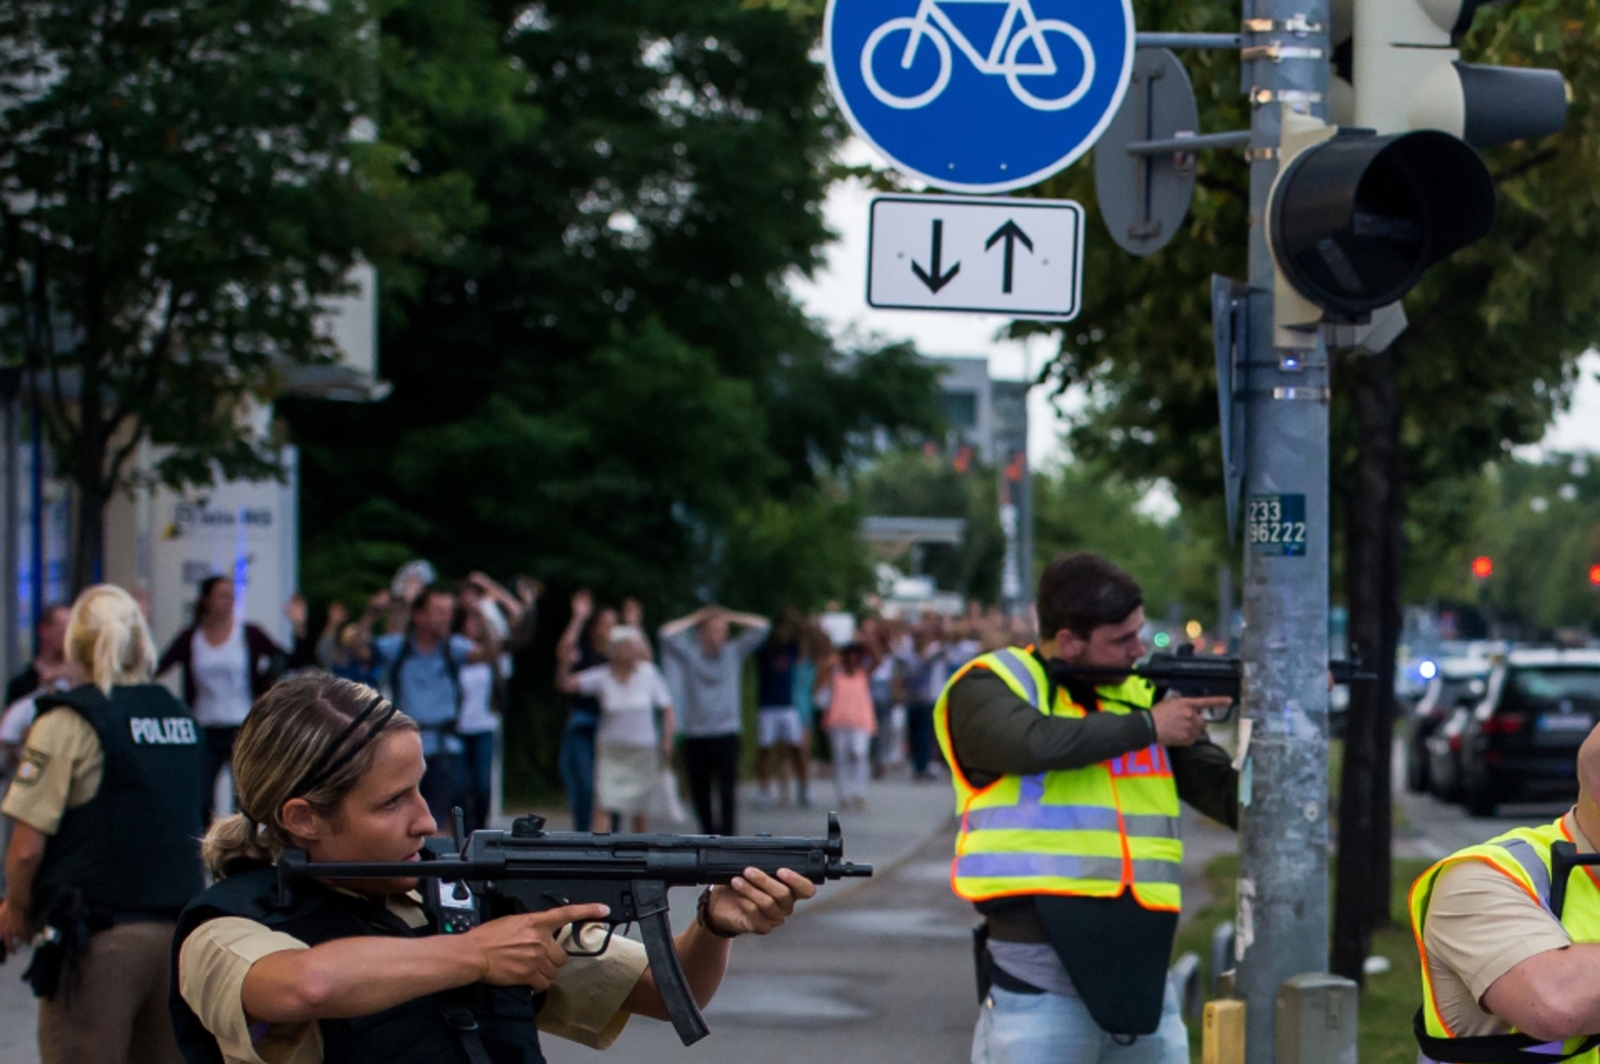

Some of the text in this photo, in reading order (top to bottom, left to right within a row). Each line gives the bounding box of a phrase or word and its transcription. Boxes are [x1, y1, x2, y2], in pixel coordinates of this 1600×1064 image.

[1249, 501, 1281, 522] 233
[1249, 522, 1306, 543] 96222
[130, 717, 198, 744] POLIZEI
